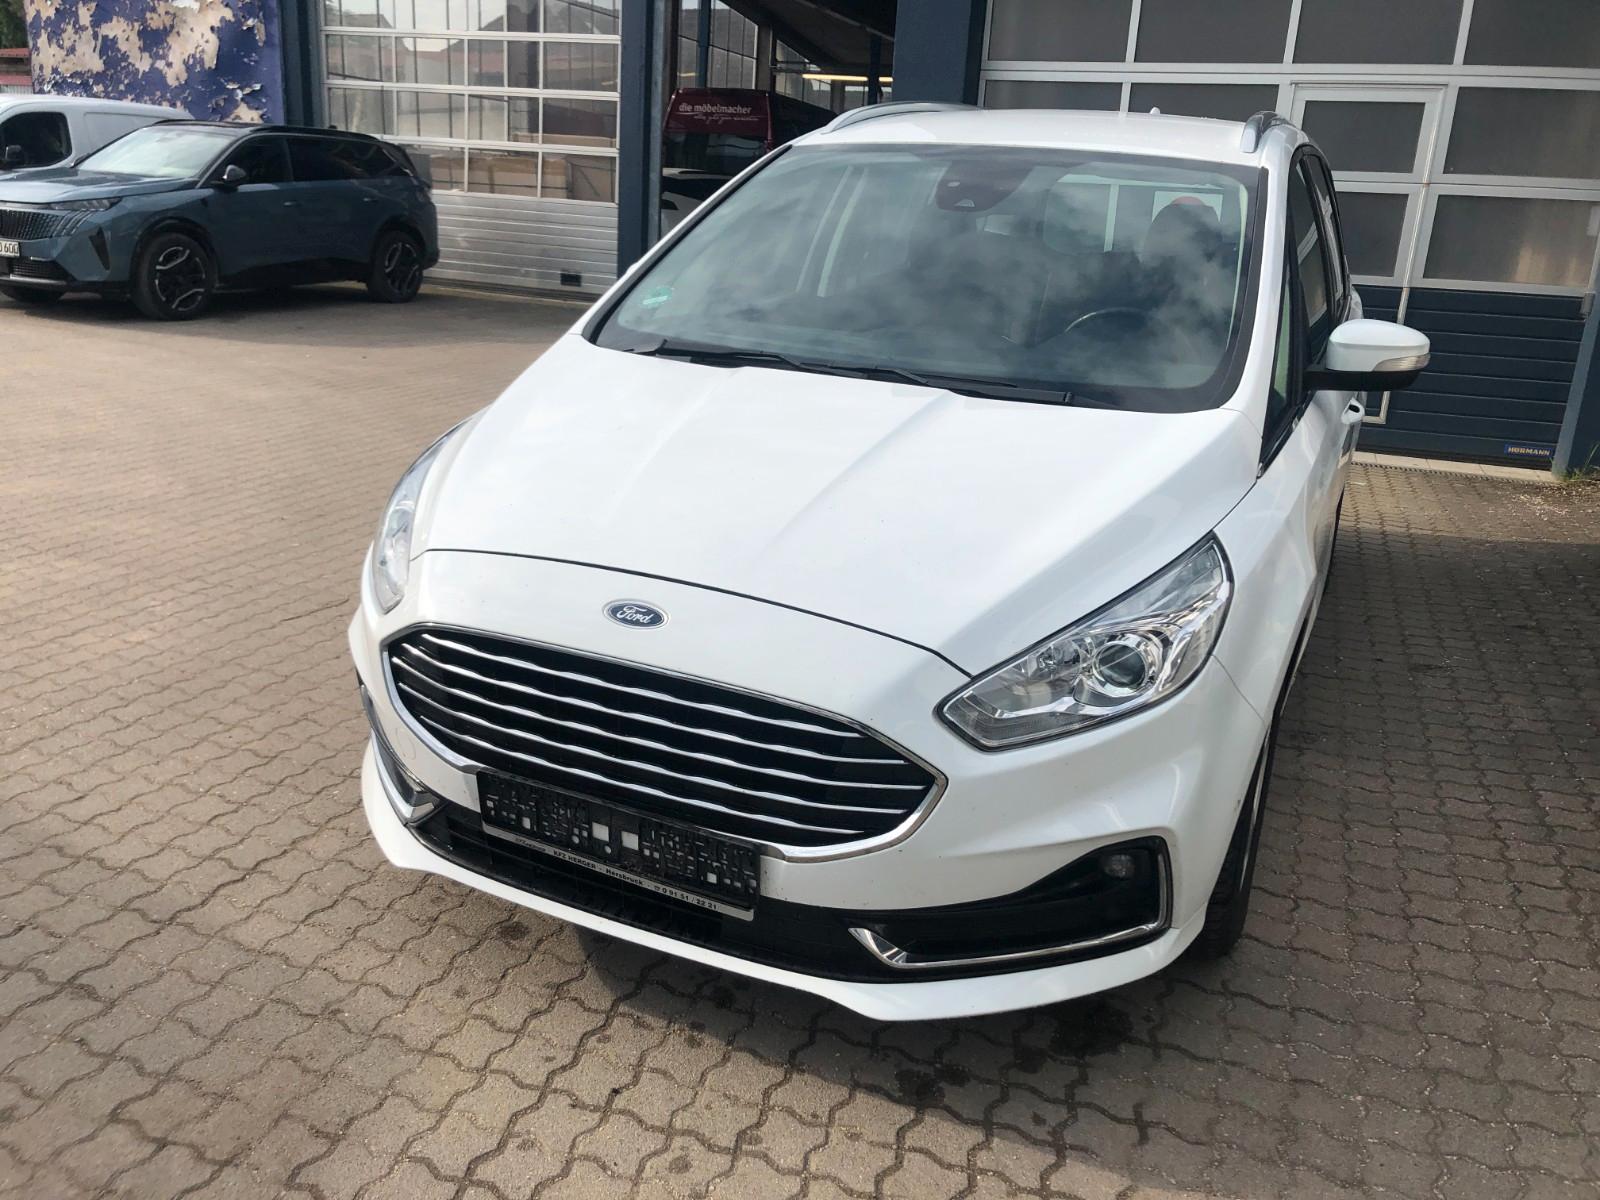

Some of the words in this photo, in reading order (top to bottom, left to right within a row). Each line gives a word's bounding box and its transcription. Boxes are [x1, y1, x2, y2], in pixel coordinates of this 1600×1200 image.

[679, 102, 693, 112] die
[694, 103, 752, 114] möbelmacher
[616, 605, 655, 624] Ford
